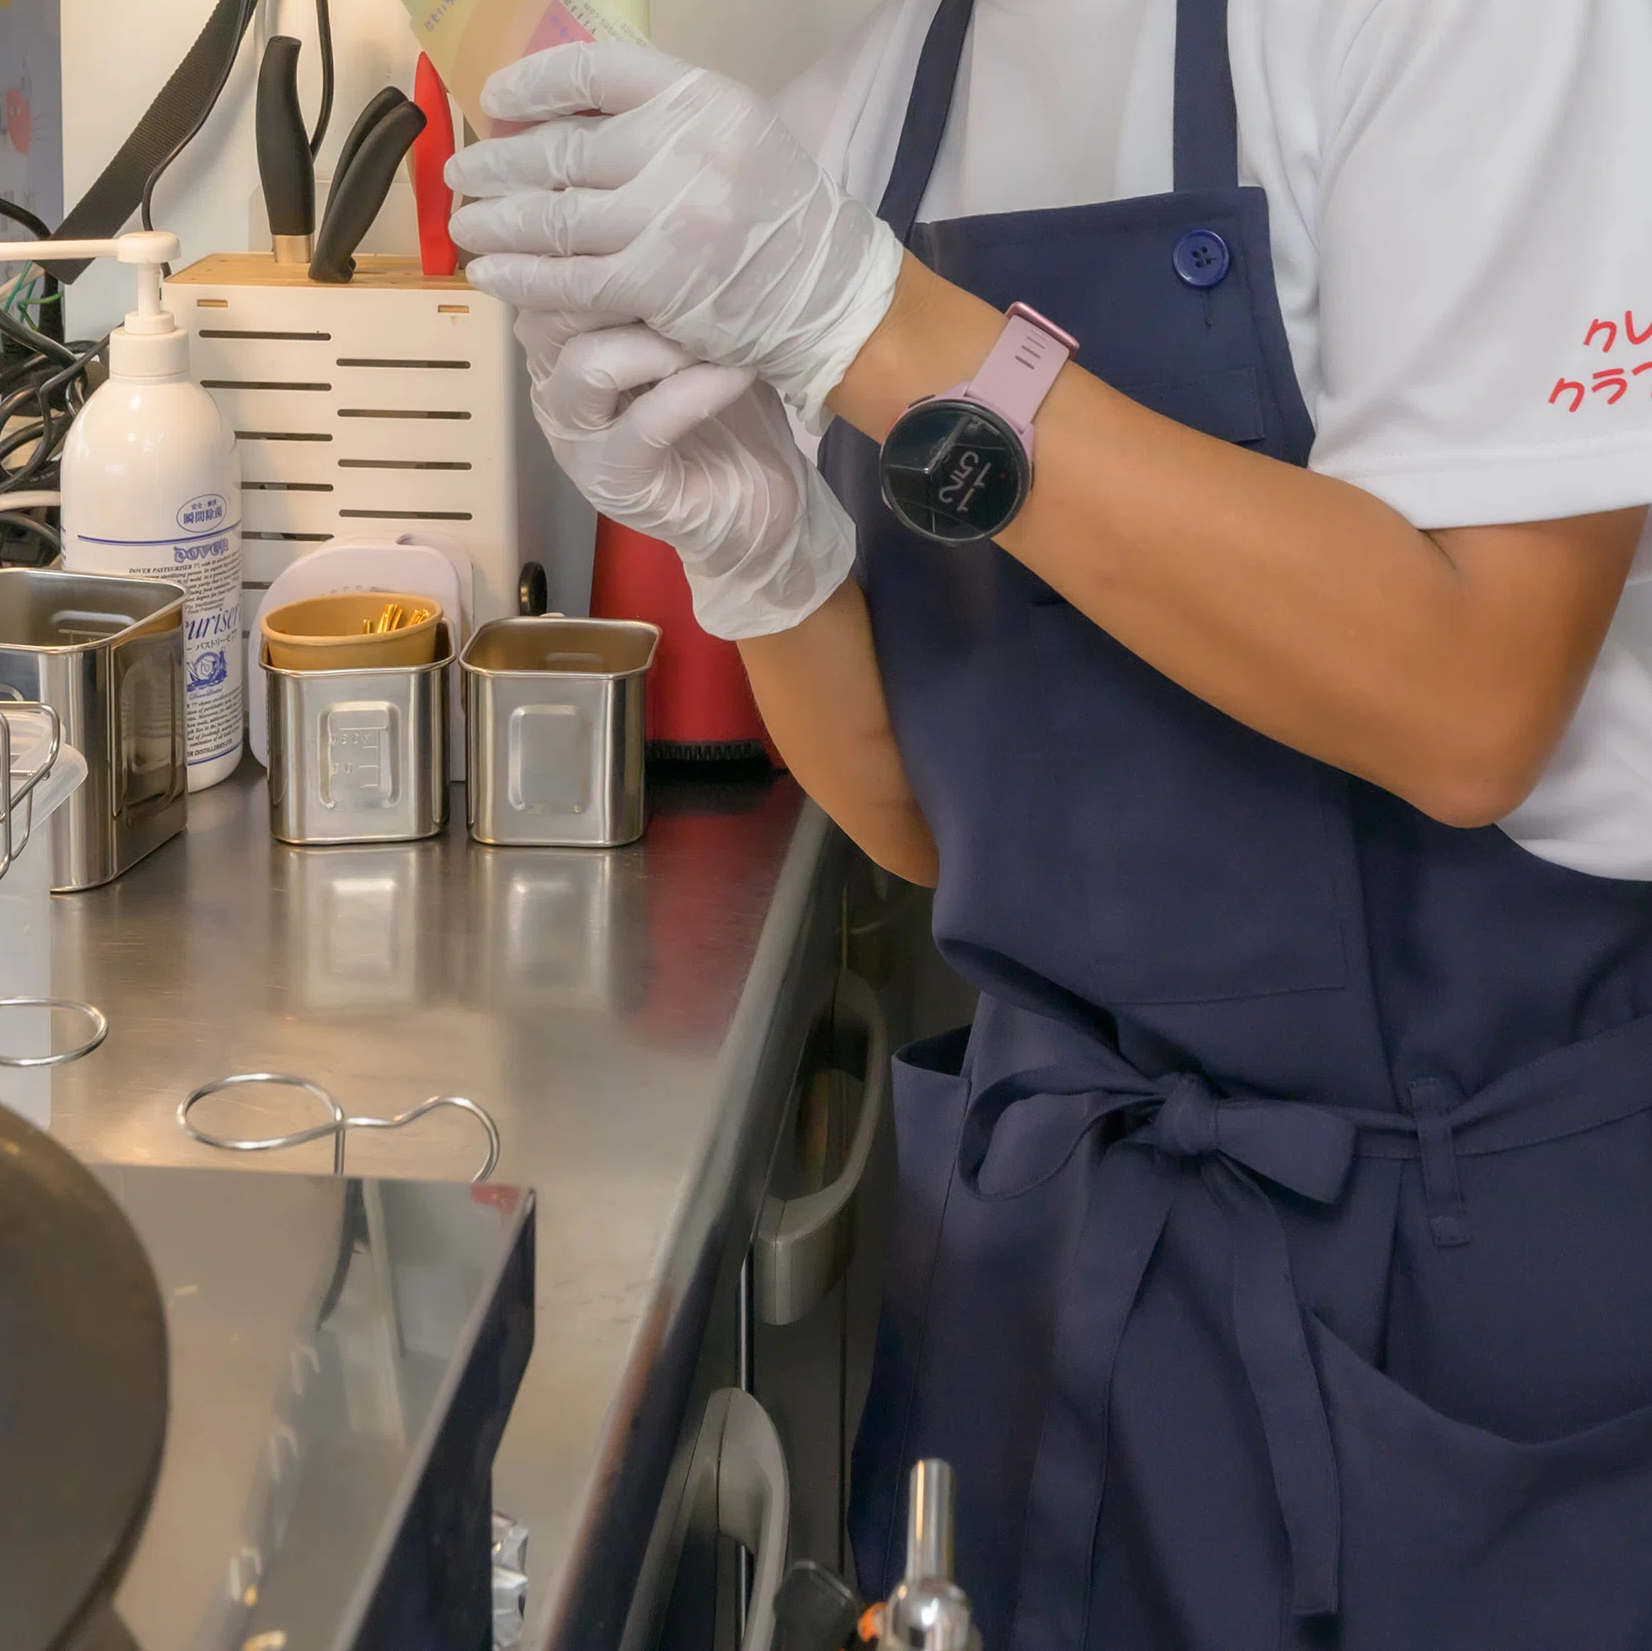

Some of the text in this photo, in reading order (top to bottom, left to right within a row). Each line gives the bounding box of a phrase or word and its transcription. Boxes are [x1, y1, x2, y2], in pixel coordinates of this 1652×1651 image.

[183, 506, 222, 524] 瞬間除菌
[173, 538, 229, 563] DOVER
